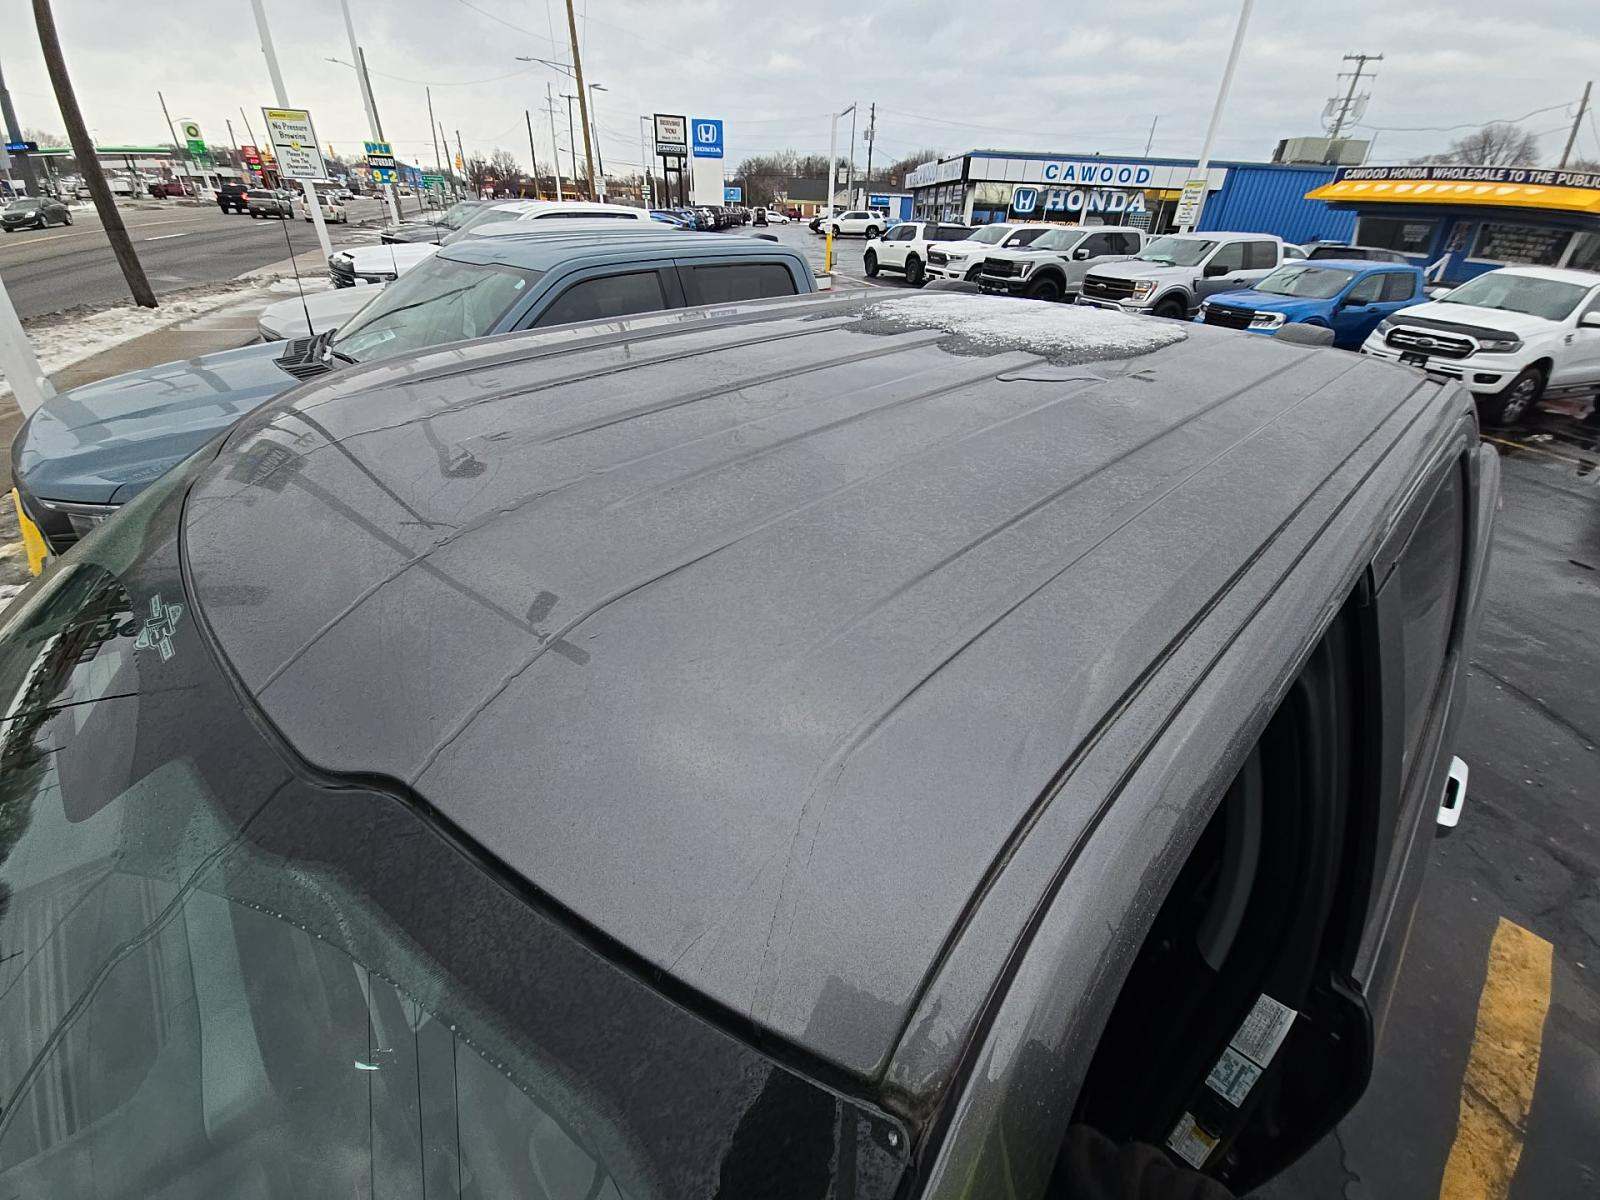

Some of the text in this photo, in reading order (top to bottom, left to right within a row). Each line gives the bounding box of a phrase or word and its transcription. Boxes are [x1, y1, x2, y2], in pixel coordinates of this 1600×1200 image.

[282, 121, 307, 131] Pressure
[279, 131, 306, 141] Browsing
[364, 143, 391, 154] OPEN
[1045, 164, 1150, 183] CAWOOD
[1344, 168, 1388, 179] CAWOOD
[1389, 168, 1428, 179] HONDA
[1432, 168, 1505, 181] WHOLESALE
[1508, 170, 1525, 182] TO
[1526, 171, 1555, 184] THE
[1045, 188, 1147, 213] HONDA
